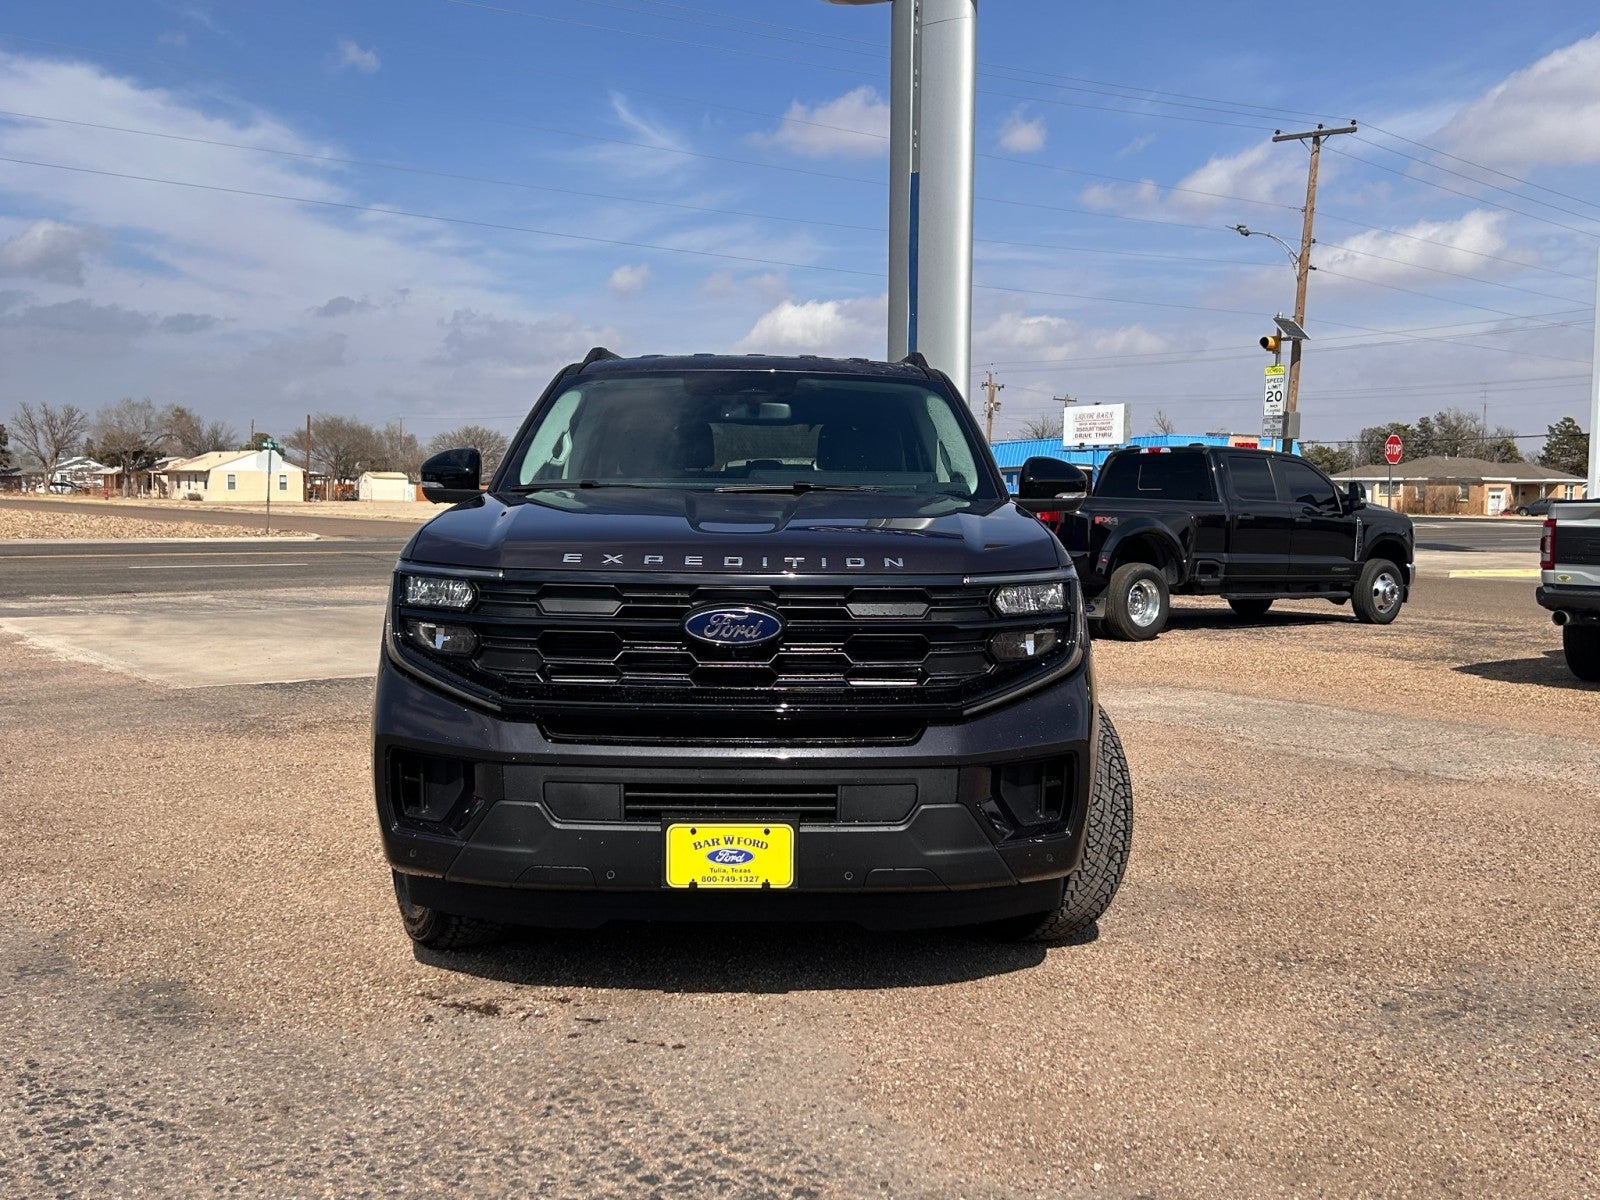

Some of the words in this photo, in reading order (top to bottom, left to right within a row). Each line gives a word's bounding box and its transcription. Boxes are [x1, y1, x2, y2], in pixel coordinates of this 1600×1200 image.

[1266, 390, 1282, 402] 20
[1386, 444, 1400, 455] STOP
[1094, 516, 1118, 526] FX4
[562, 553, 905, 568] EXPEDITION
[703, 612, 763, 639] Ford
[693, 838, 720, 850] BAR
[724, 836, 734, 845] W
[737, 837, 768, 850] FORD
[715, 850, 746, 862] Ford
